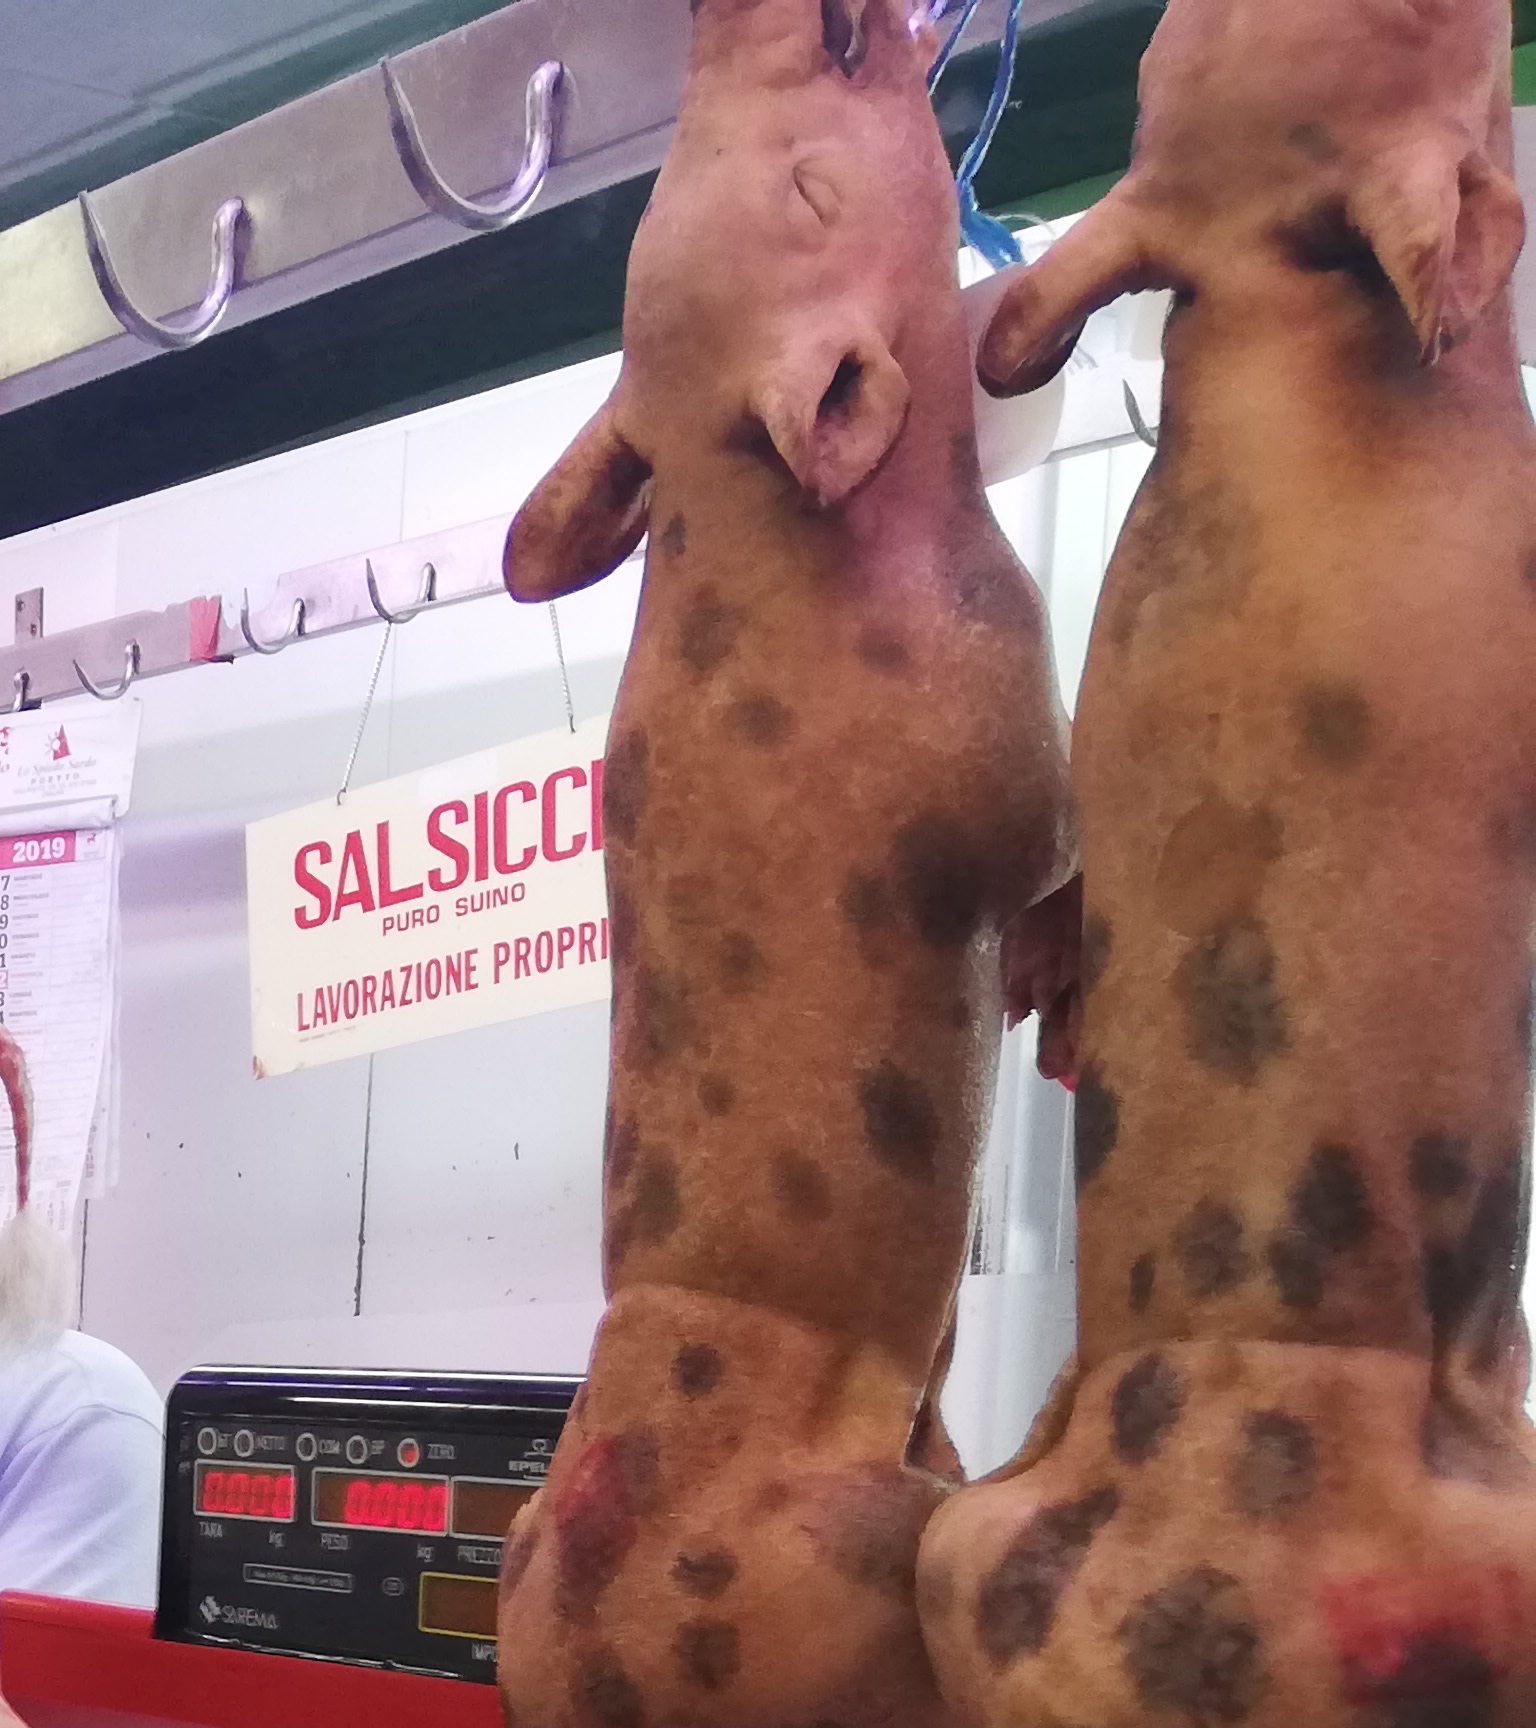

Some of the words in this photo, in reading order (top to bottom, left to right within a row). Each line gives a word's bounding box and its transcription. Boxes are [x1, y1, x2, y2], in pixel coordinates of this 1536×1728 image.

[12, 836, 66, 864] 2019
[381, 903, 441, 937] PURO
[454, 882, 526, 918] SUINO
[296, 947, 480, 1033] LAVORAZIONE
[198, 1521, 224, 1538] TARA
